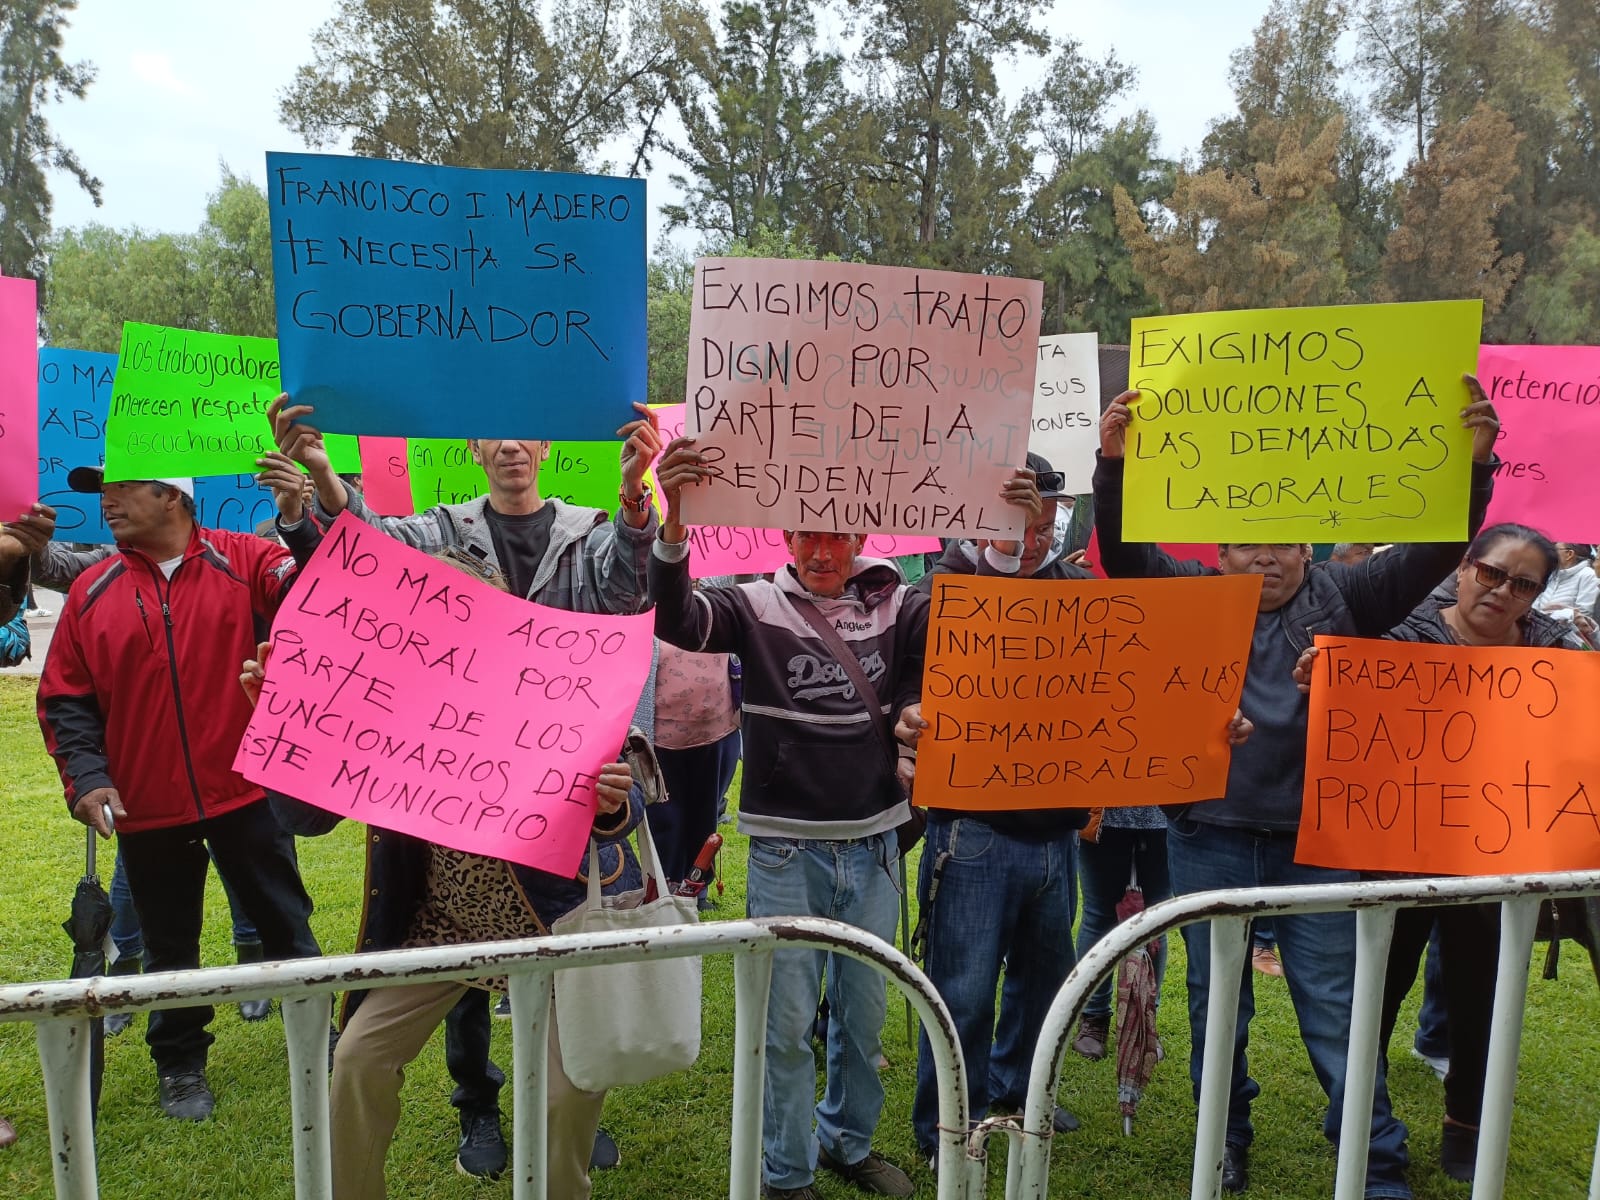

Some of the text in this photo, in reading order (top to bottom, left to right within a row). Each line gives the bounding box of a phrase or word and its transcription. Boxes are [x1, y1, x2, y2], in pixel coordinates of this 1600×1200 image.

[276, 167, 449, 216] FRANCISCO
[506, 191, 630, 236] MADERO
[339, 230, 498, 286] NECESITA
[525, 243, 592, 274] SR.
[293, 289, 613, 361] GOBERNADOR.
[702, 267, 1025, 356] EXIGIMOS TRATO
[158, 334, 280, 387] trabajadore
[702, 337, 938, 393] DIGNO POR
[1138, 328, 1363, 375] EXIGIMOS
[73, 364, 114, 403] MA
[1040, 377, 1086, 397] SUS
[1136, 377, 1438, 430] SOLUCIONES A
[41, 408, 107, 440] AB
[695, 386, 818, 459] PARTE
[851, 402, 902, 442] DE
[923, 403, 974, 445] LA
[1137, 424, 1449, 471] LAS DEMANDAS
[444, 446, 473, 468] con
[556, 450, 590, 474] los
[800, 498, 1012, 531] MUNICIPAL.
[1167, 474, 1426, 519] LABORALES
[327, 527, 626, 664] NO MAS ACOSO
[937, 584, 1145, 636] EXIGIMOS
[298, 578, 600, 709] LABORAL POR
[936, 627, 1150, 670] INMEDIATA
[270, 630, 584, 753] PARTE DE LOS
[929, 661, 1240, 712] SOLUCIONES A LAS
[1320, 645, 1558, 718] TRABAJAMOS
[935, 711, 1138, 753] DEMANDAS
[1327, 709, 1476, 763] BAJO
[534, 768, 597, 807] DE
[949, 753, 1198, 789] LABORALES
[1317, 760, 1600, 854] PROTESTA
